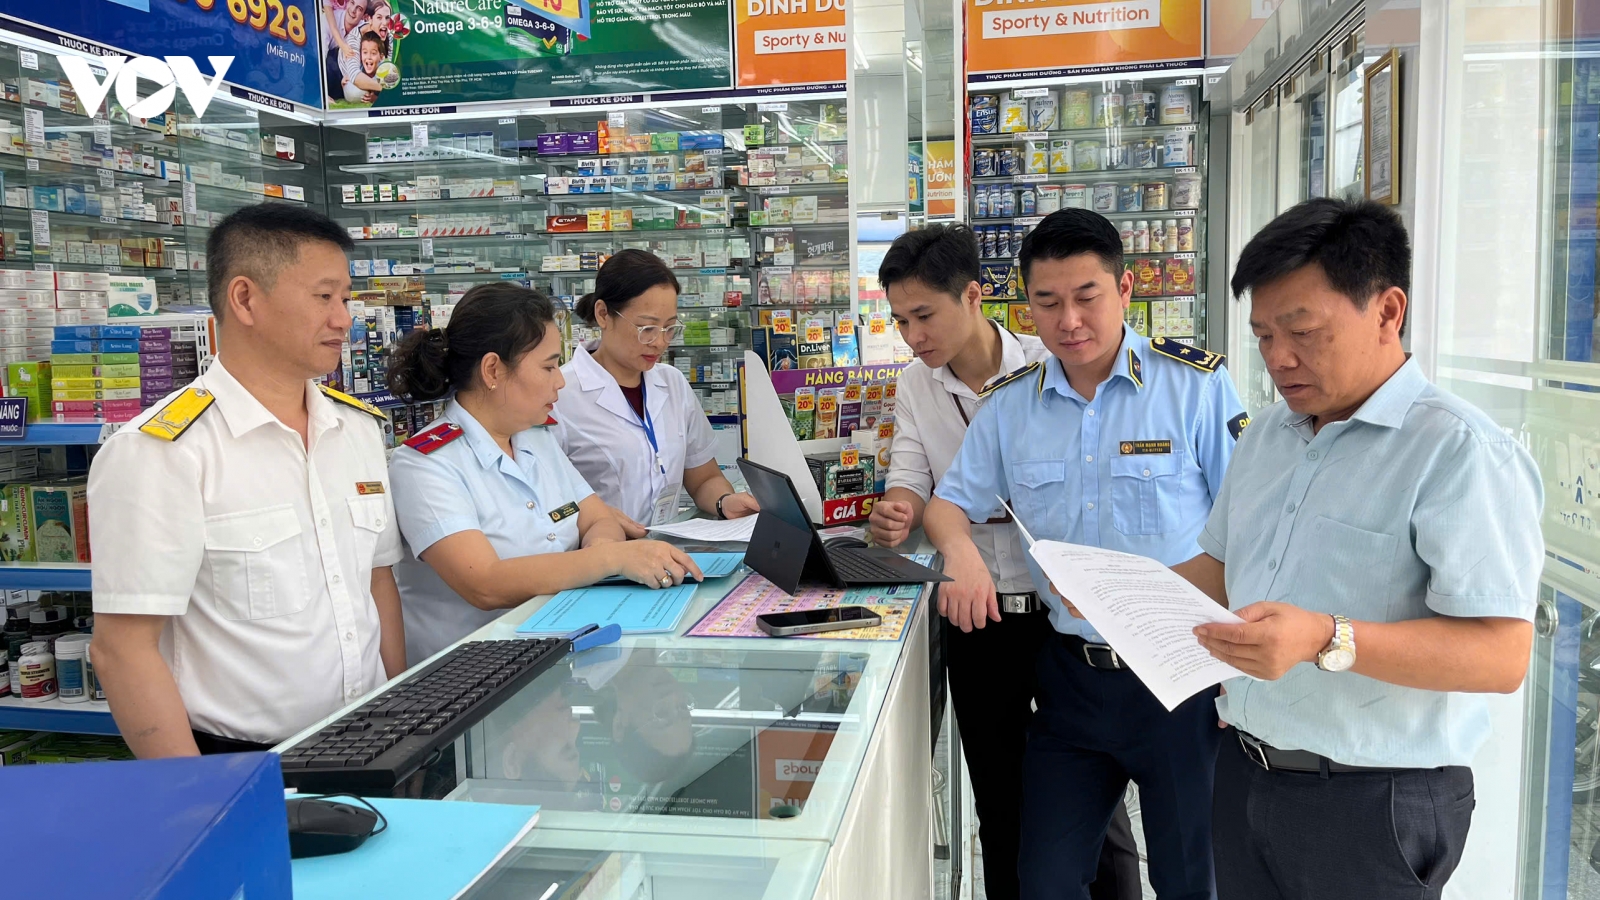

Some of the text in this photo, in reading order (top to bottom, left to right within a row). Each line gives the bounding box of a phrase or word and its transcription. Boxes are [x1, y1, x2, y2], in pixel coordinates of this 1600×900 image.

[508, 17, 555, 32] OMEGA 3-6-9
[992, 6, 1149, 34] Sporty & Nutrition
[414, 15, 502, 35] Omega 3-6-9
[763, 34, 810, 50] Sporty
[814, 33, 824, 44] &
[290, 52, 305, 67] phí)
[775, 323, 789, 332] 20%
[839, 324, 853, 334] 20%
[871, 324, 884, 333] 20%
[808, 332, 822, 341] 20%
[800, 343, 830, 352] Dr.Liver
[805, 369, 844, 385] HÀNG
[846, 390, 860, 399] 20%
[868, 391, 882, 400] 20%
[798, 400, 813, 409] 20%
[820, 401, 835, 411] 20%
[879, 428, 892, 437] 20%
[843, 456, 857, 465] 20%
[833, 501, 856, 519] GIÁ
